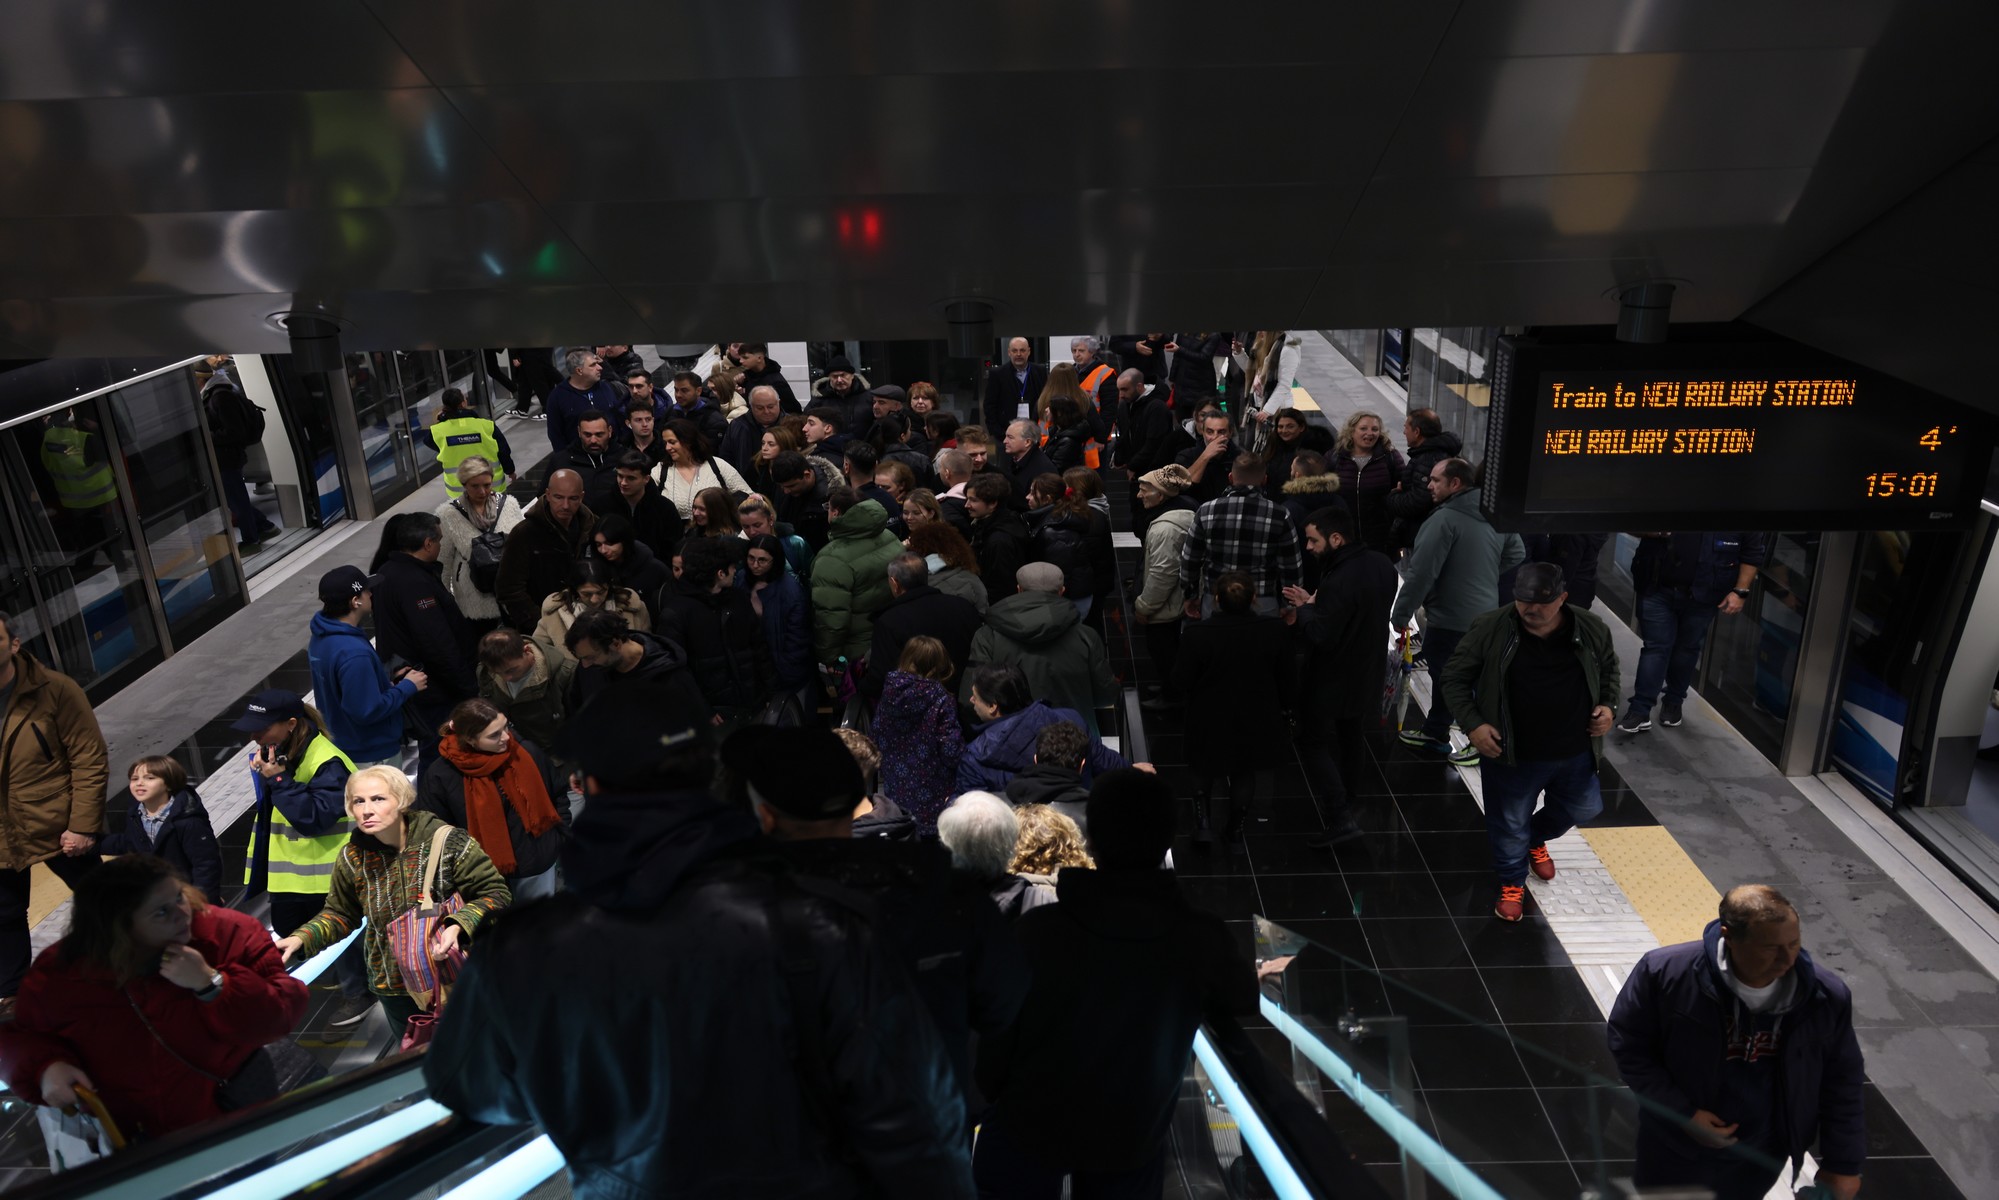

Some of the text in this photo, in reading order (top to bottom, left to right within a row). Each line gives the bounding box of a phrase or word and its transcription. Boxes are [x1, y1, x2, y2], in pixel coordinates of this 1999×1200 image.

[1553, 380, 1856, 408] Train to NEW RAILWAY STATION
[1545, 428, 1755, 454] NEW RAILWAY STATION
[1867, 472, 1938, 497] 15:01
